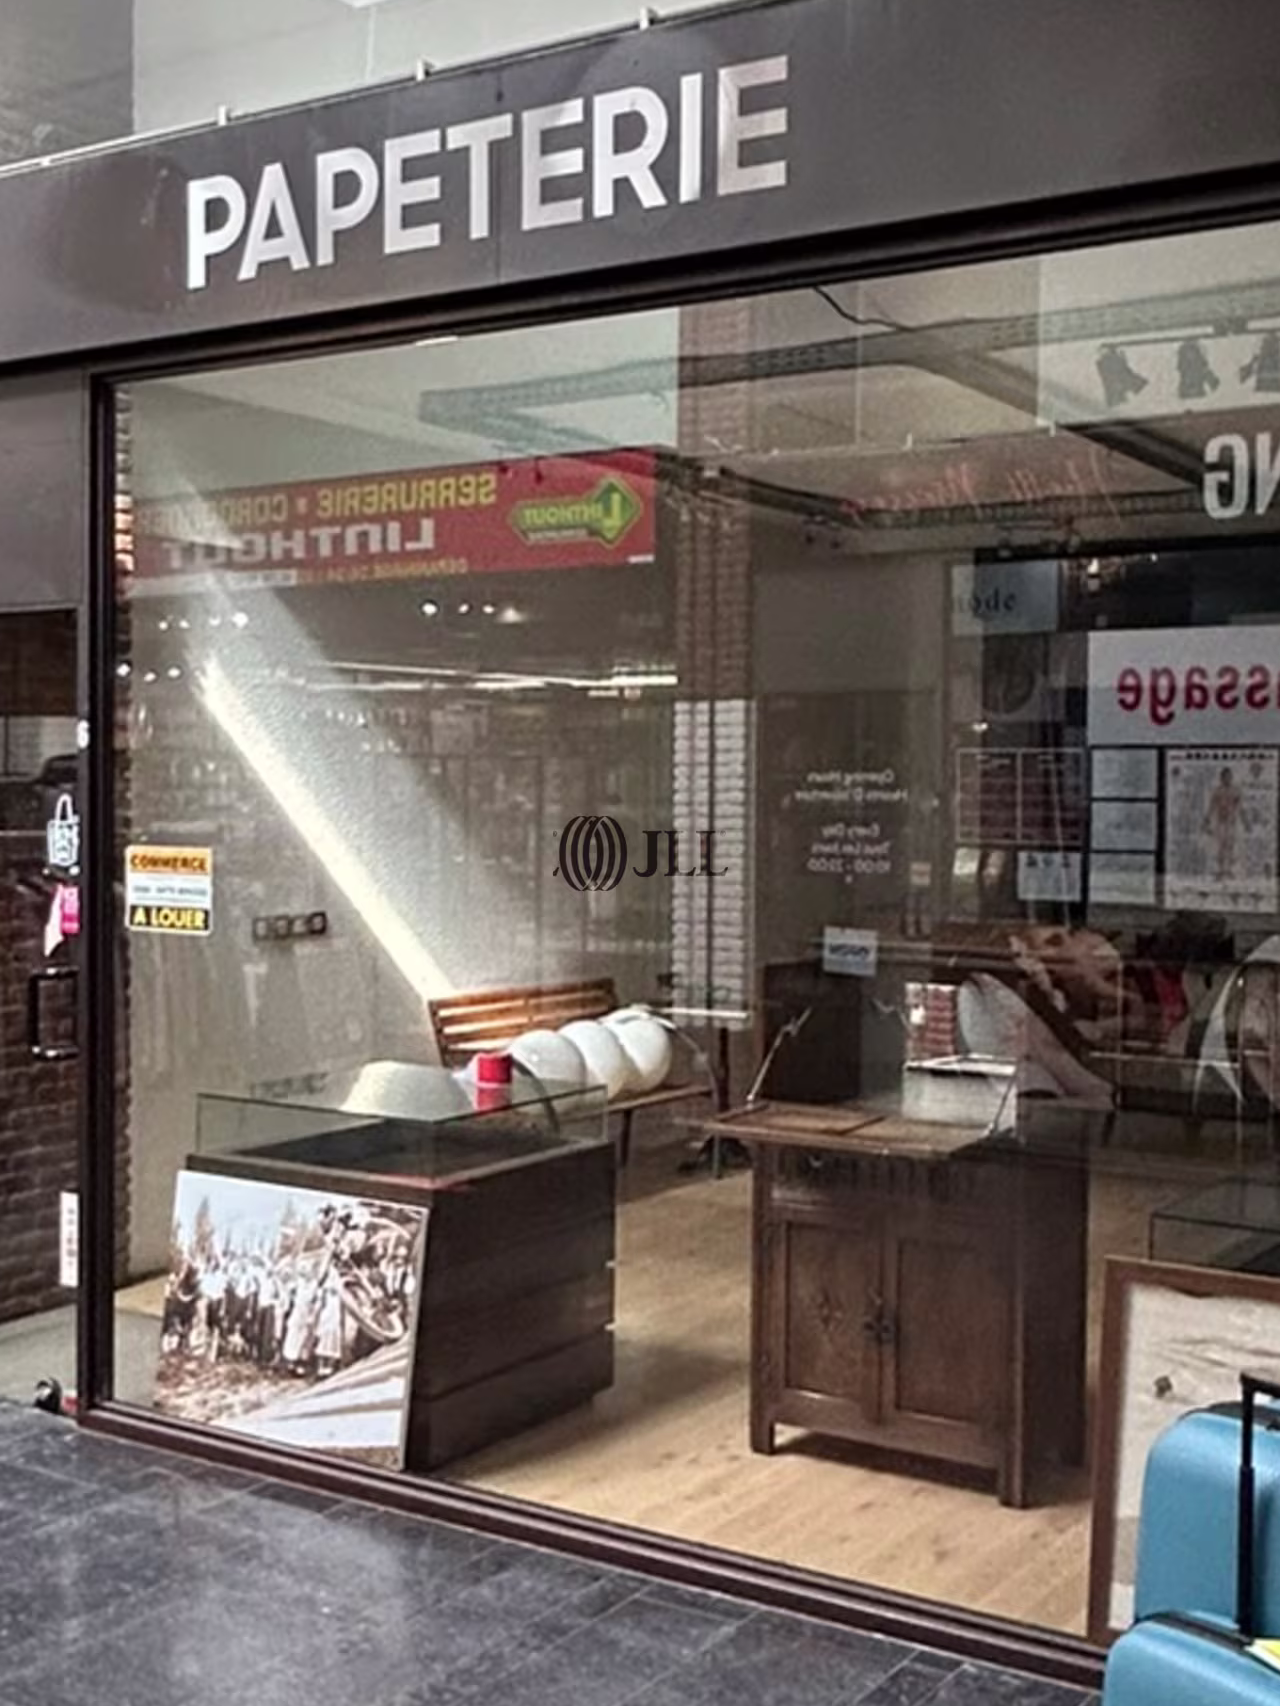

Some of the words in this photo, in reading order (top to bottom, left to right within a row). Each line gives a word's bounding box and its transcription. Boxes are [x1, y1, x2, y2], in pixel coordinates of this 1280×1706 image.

[186, 54, 789, 291] PAPETERIE
[130, 853, 207, 871] COMMERCE
[151, 907, 206, 929] LOUER
